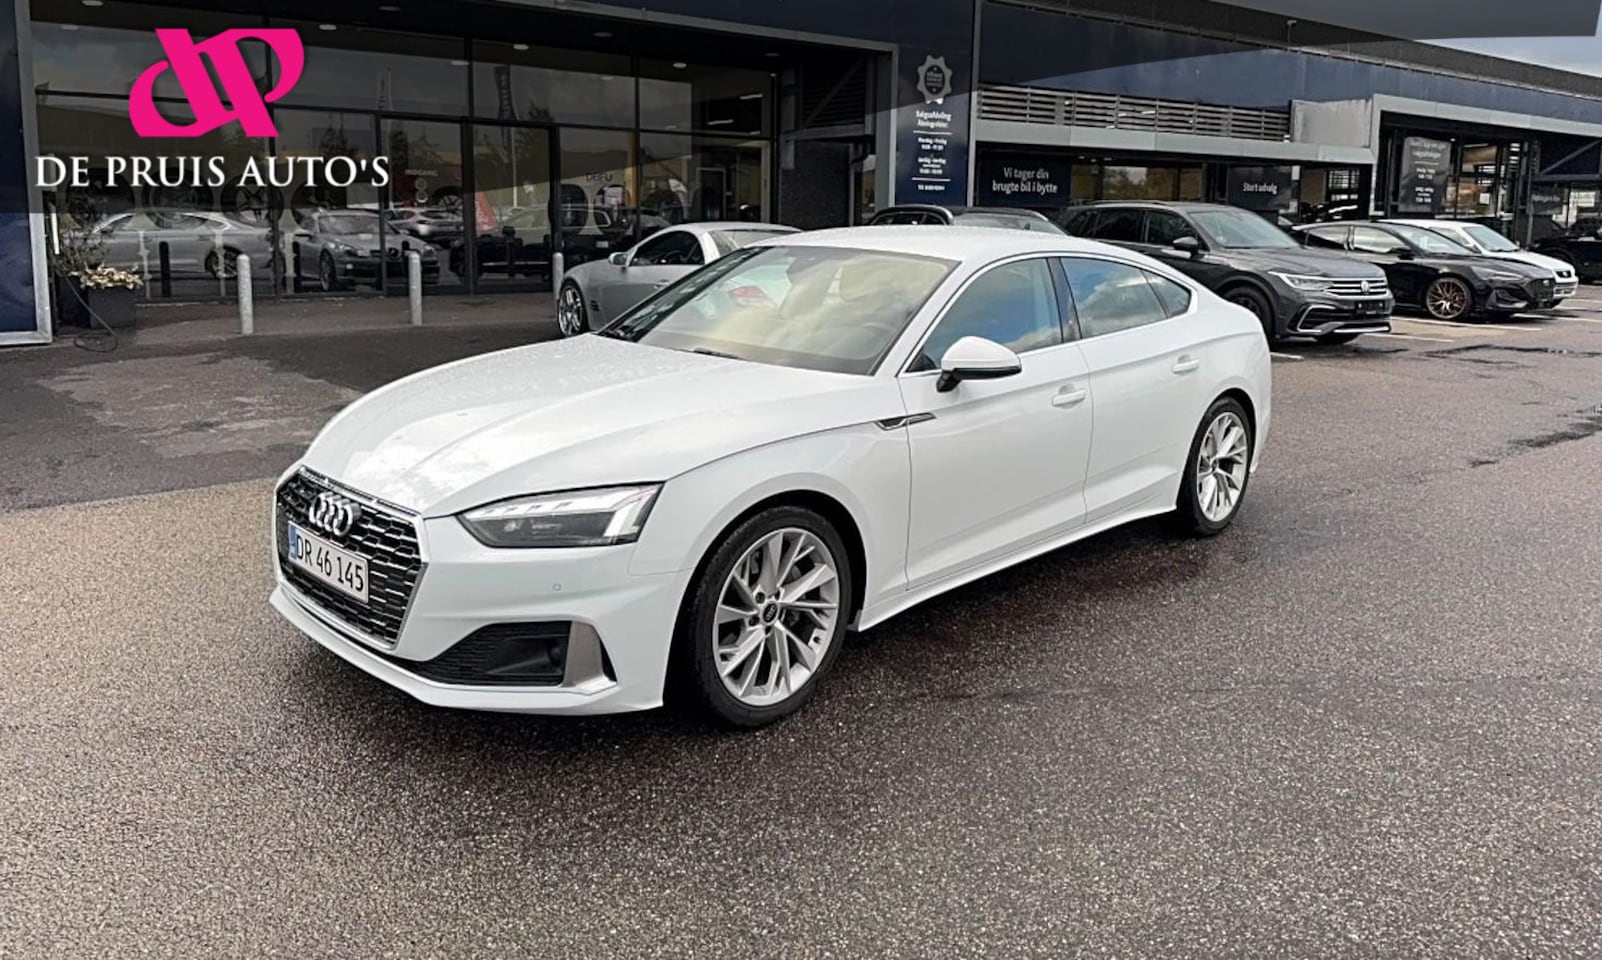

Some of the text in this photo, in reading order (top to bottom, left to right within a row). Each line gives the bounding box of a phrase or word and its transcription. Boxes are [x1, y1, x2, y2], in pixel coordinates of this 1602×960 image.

[1003, 167, 1049, 181] Vi tager din
[992, 179, 1019, 194] brugte
[1020, 180, 1031, 192] bil
[1036, 180, 1058, 195] bytte
[296, 535, 364, 592] DR 46 145
